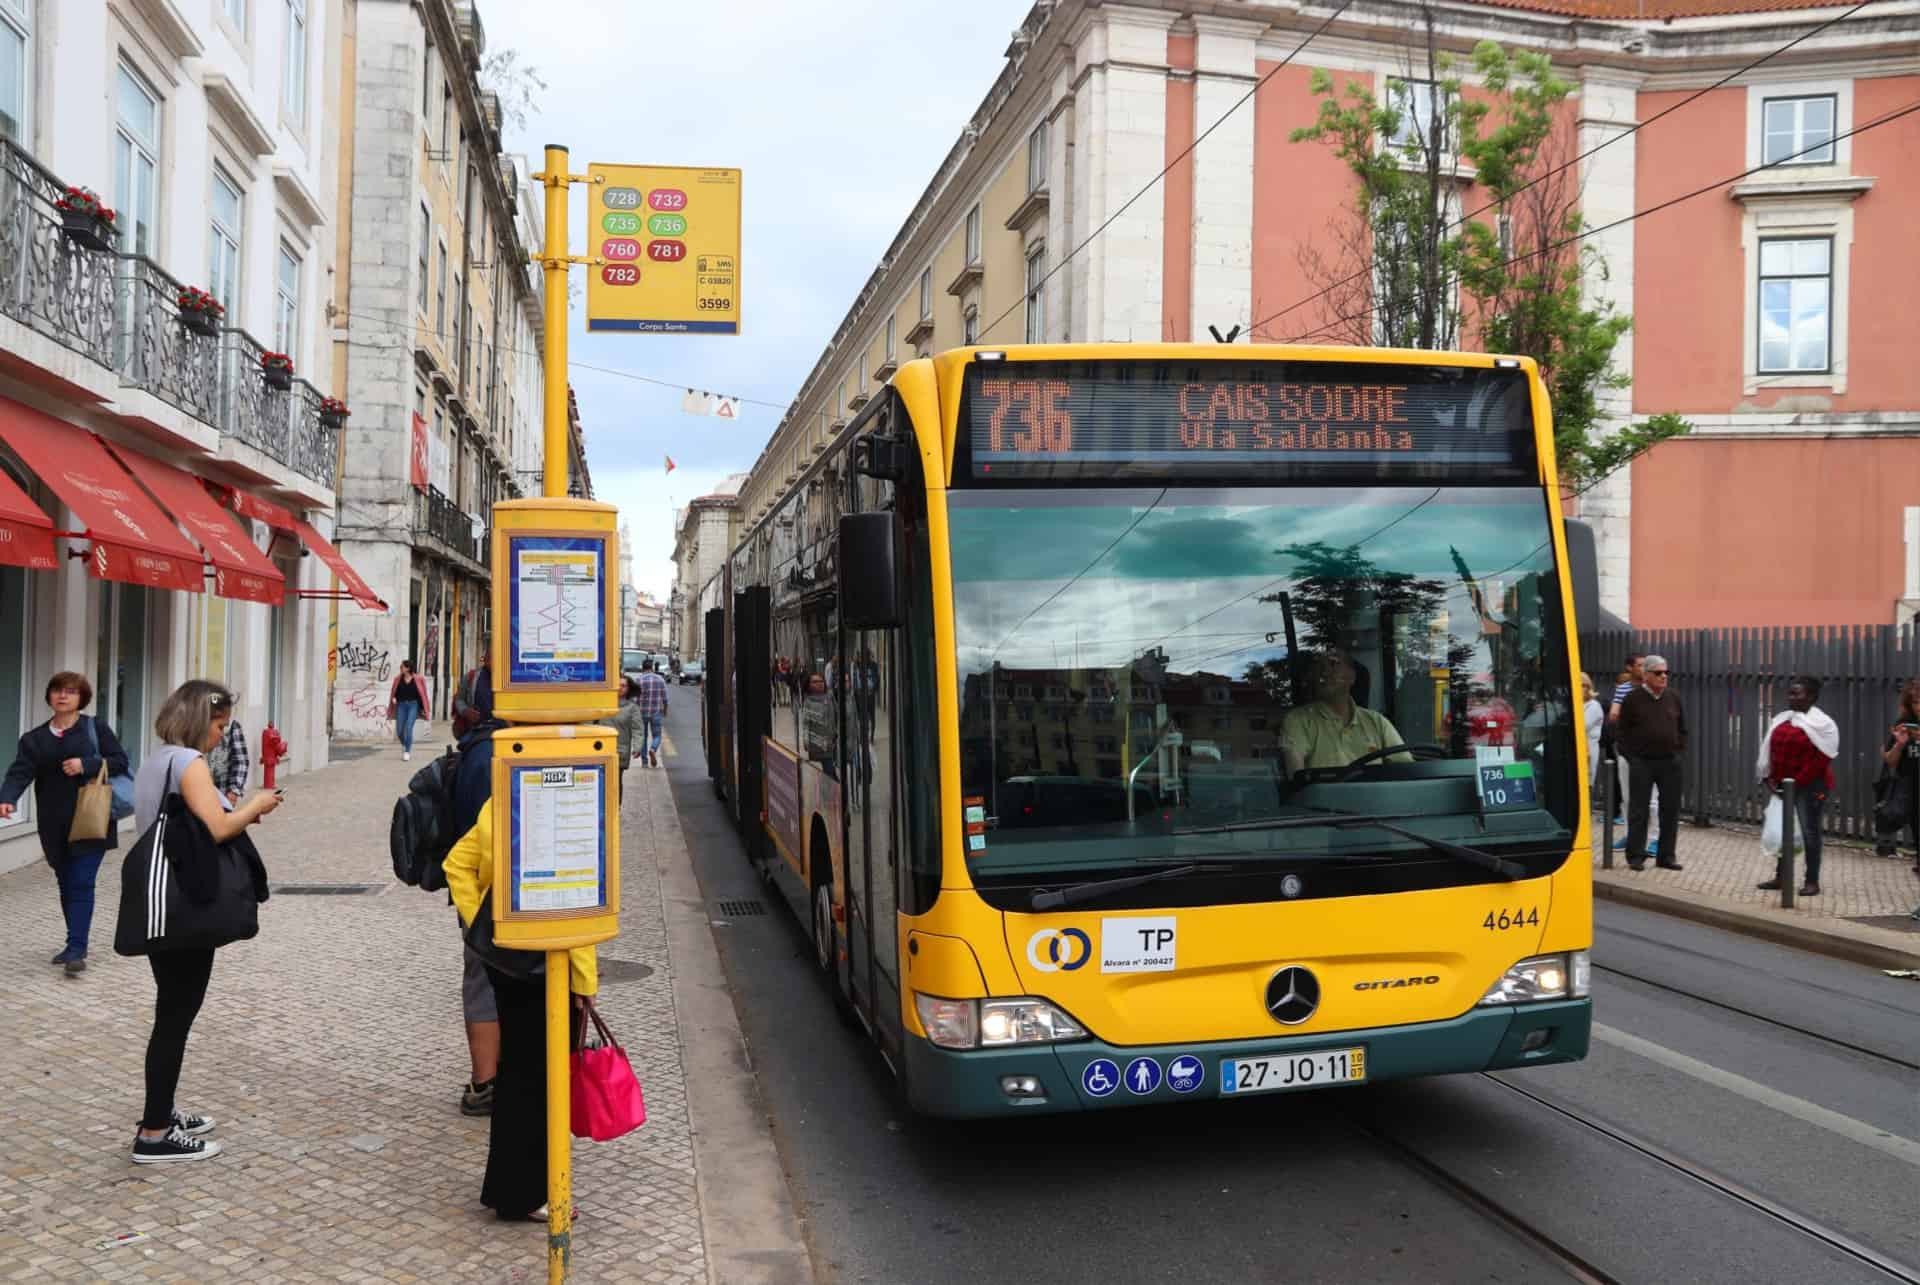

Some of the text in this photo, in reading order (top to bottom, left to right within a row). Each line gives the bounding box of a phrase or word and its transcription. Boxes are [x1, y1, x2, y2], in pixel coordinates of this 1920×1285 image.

[607, 192, 636, 205] 728
[653, 194, 682, 207] 732
[608, 217, 636, 230] 735
[654, 218, 681, 231] 736
[607, 243, 636, 256] 760
[652, 244, 680, 257] 781
[607, 268, 636, 281] 782
[698, 298, 731, 309] 3599
[639, 321, 688, 332] Corpo Santo
[1179, 384, 1409, 423] CAIS SODRE
[982, 379, 1072, 453] 736
[1180, 423, 1413, 449] Via Saldanha
[1483, 769, 1504, 780] 736
[1487, 789, 1507, 805] 10
[1483, 906, 1540, 931] 4644
[1137, 928, 1175, 951] TP
[1143, 957, 1174, 966] 200427
[1353, 975, 1441, 991] CITARO
